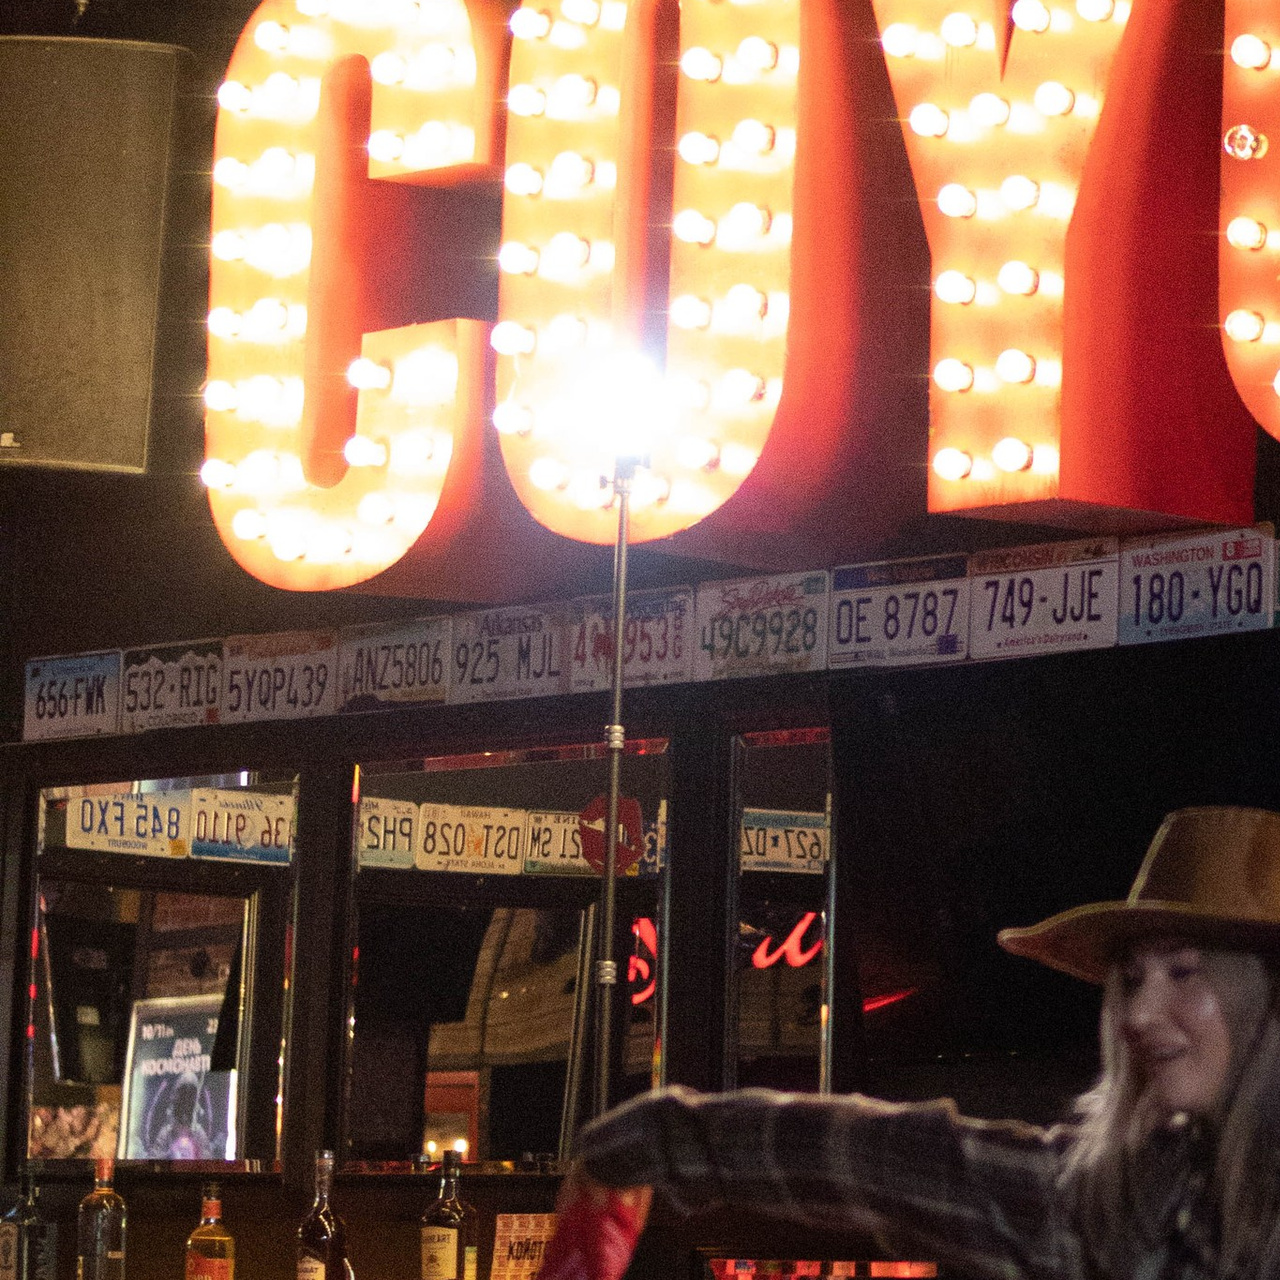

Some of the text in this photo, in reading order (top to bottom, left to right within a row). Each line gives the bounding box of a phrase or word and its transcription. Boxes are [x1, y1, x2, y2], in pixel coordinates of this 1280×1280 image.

[1131, 544, 1214, 568] WASHINGTON
[883, 589, 960, 640] 8787
[984, 570, 1104, 632] 749-JJE
[1132, 562, 1263, 627] 180-YGQ
[479, 613, 544, 638] Arkansas
[352, 639, 443, 694] ANZ5806
[456, 639, 501, 686] 925
[516, 634, 561, 681] MJL
